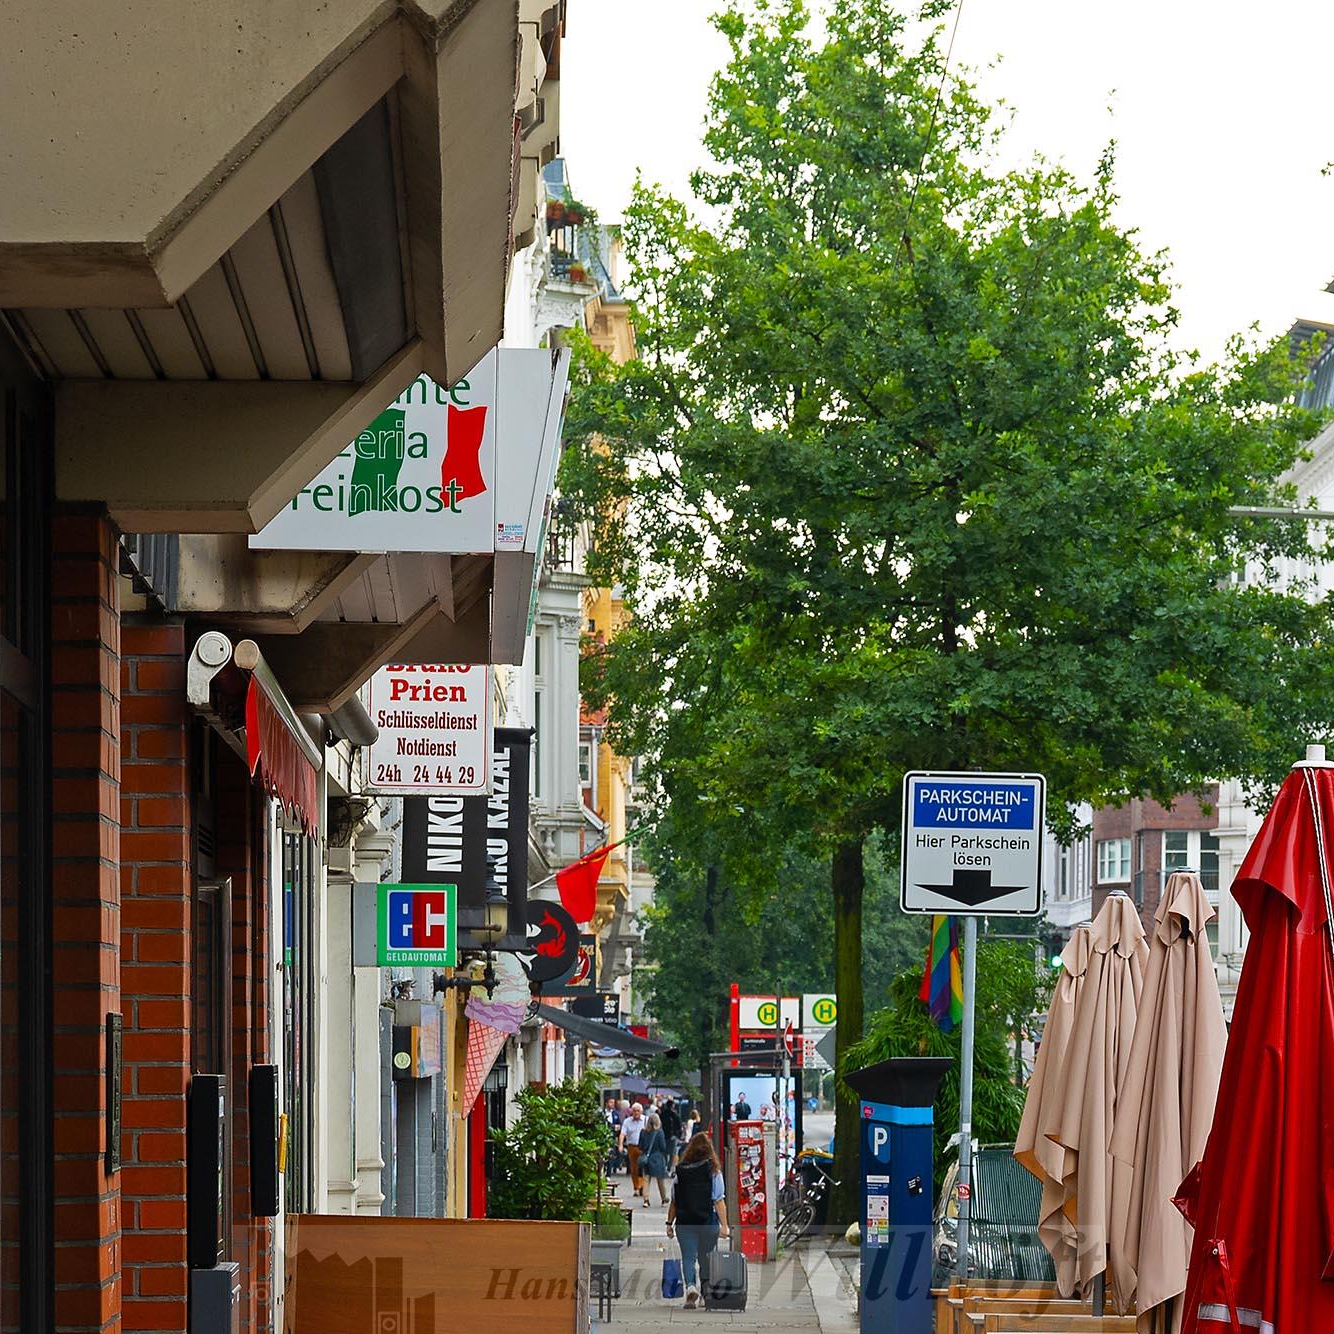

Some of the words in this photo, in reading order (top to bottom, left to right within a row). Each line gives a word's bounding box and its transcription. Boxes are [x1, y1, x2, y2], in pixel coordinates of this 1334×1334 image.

[389, 678, 468, 702] Prien
[377, 709, 478, 730] Schlüsseldienst
[396, 737, 457, 757] Notdienst
[377, 764, 402, 782] 24h
[413, 765, 430, 783] 24
[435, 766, 452, 783] 44
[458, 766, 475, 784] 29
[919, 789, 1029, 806] PARKSCHEIN-
[935, 807, 1012, 823] AUTOMAT
[916, 834, 945, 848] Hier
[951, 835, 1030, 850] Parkschein
[953, 851, 992, 866] lösen
[386, 952, 448, 962] GELDAUTOMAT
[873, 1127, 888, 1156] P
